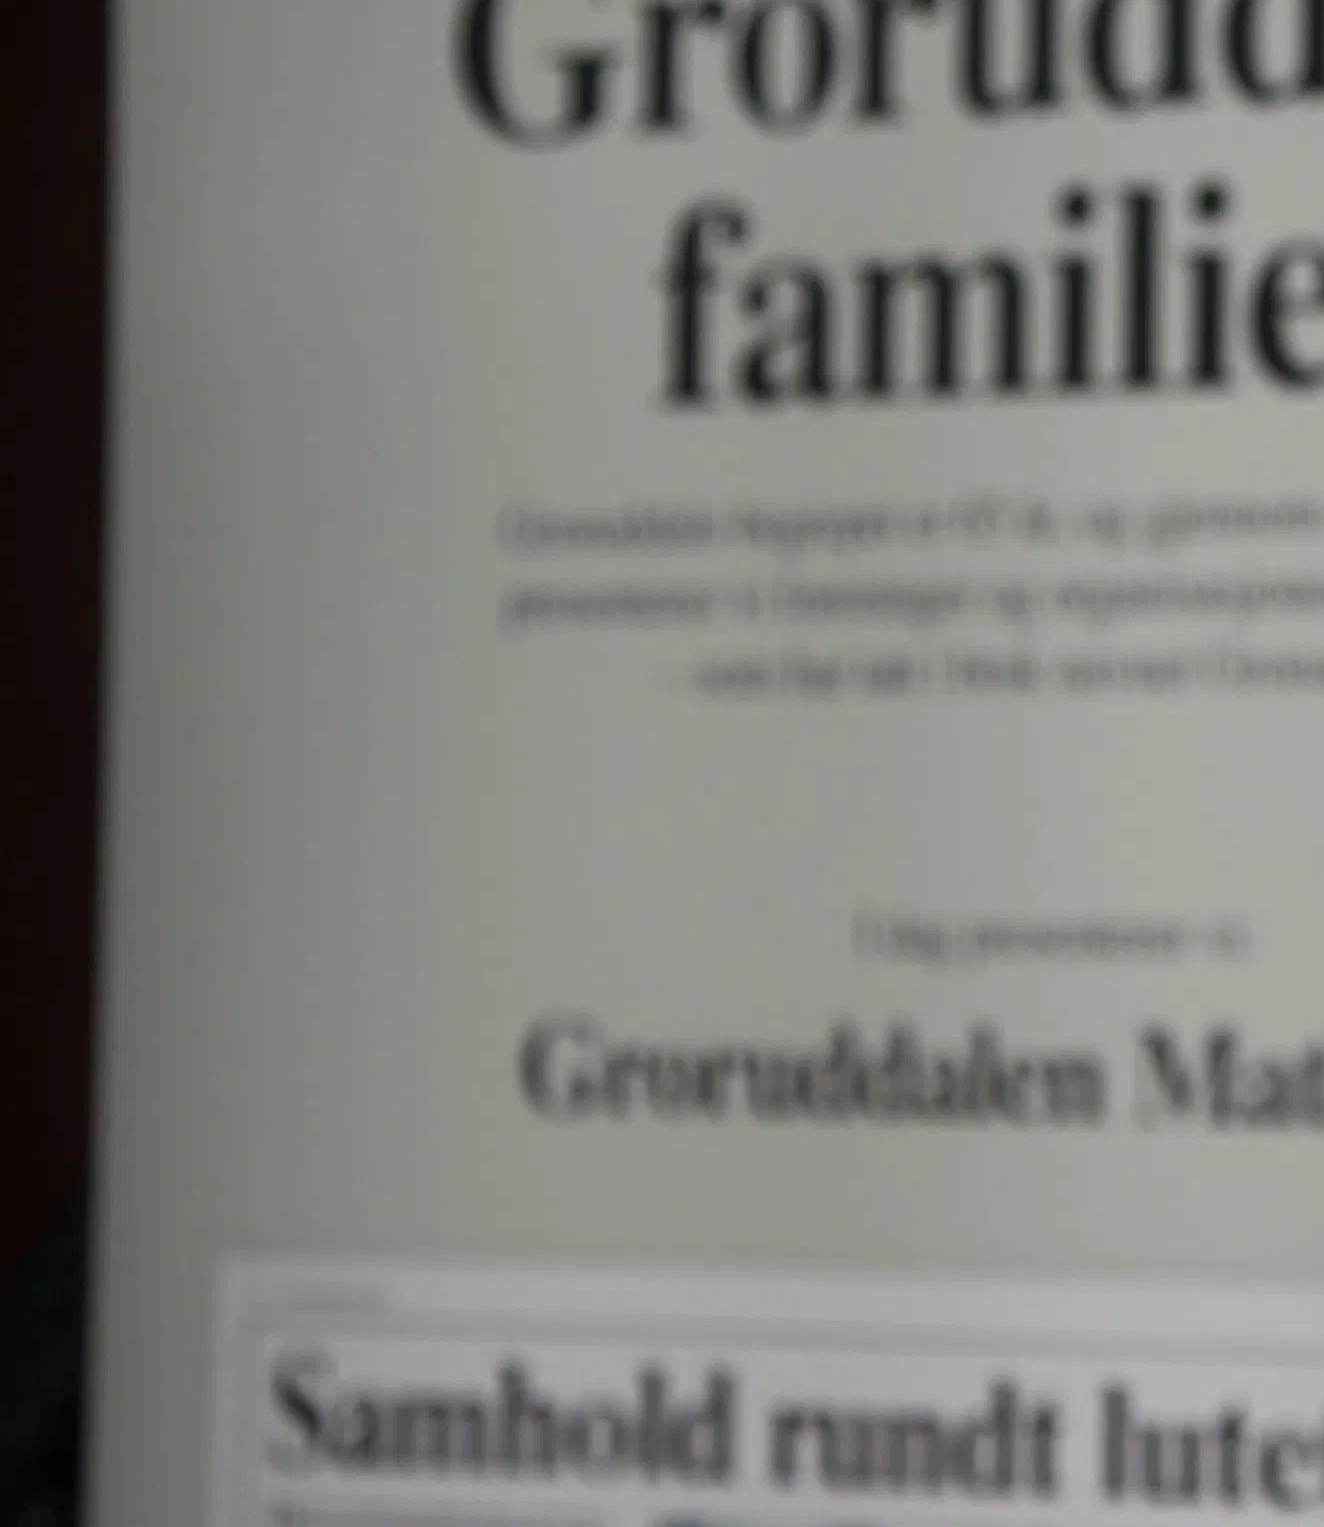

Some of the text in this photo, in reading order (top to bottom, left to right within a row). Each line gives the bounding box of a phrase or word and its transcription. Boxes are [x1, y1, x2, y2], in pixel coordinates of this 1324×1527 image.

[513, 1012, 1107, 1127] Groruddalen
[266, 1346, 738, 1487] Samhold
[765, 1369, 1061, 1501] rundt
